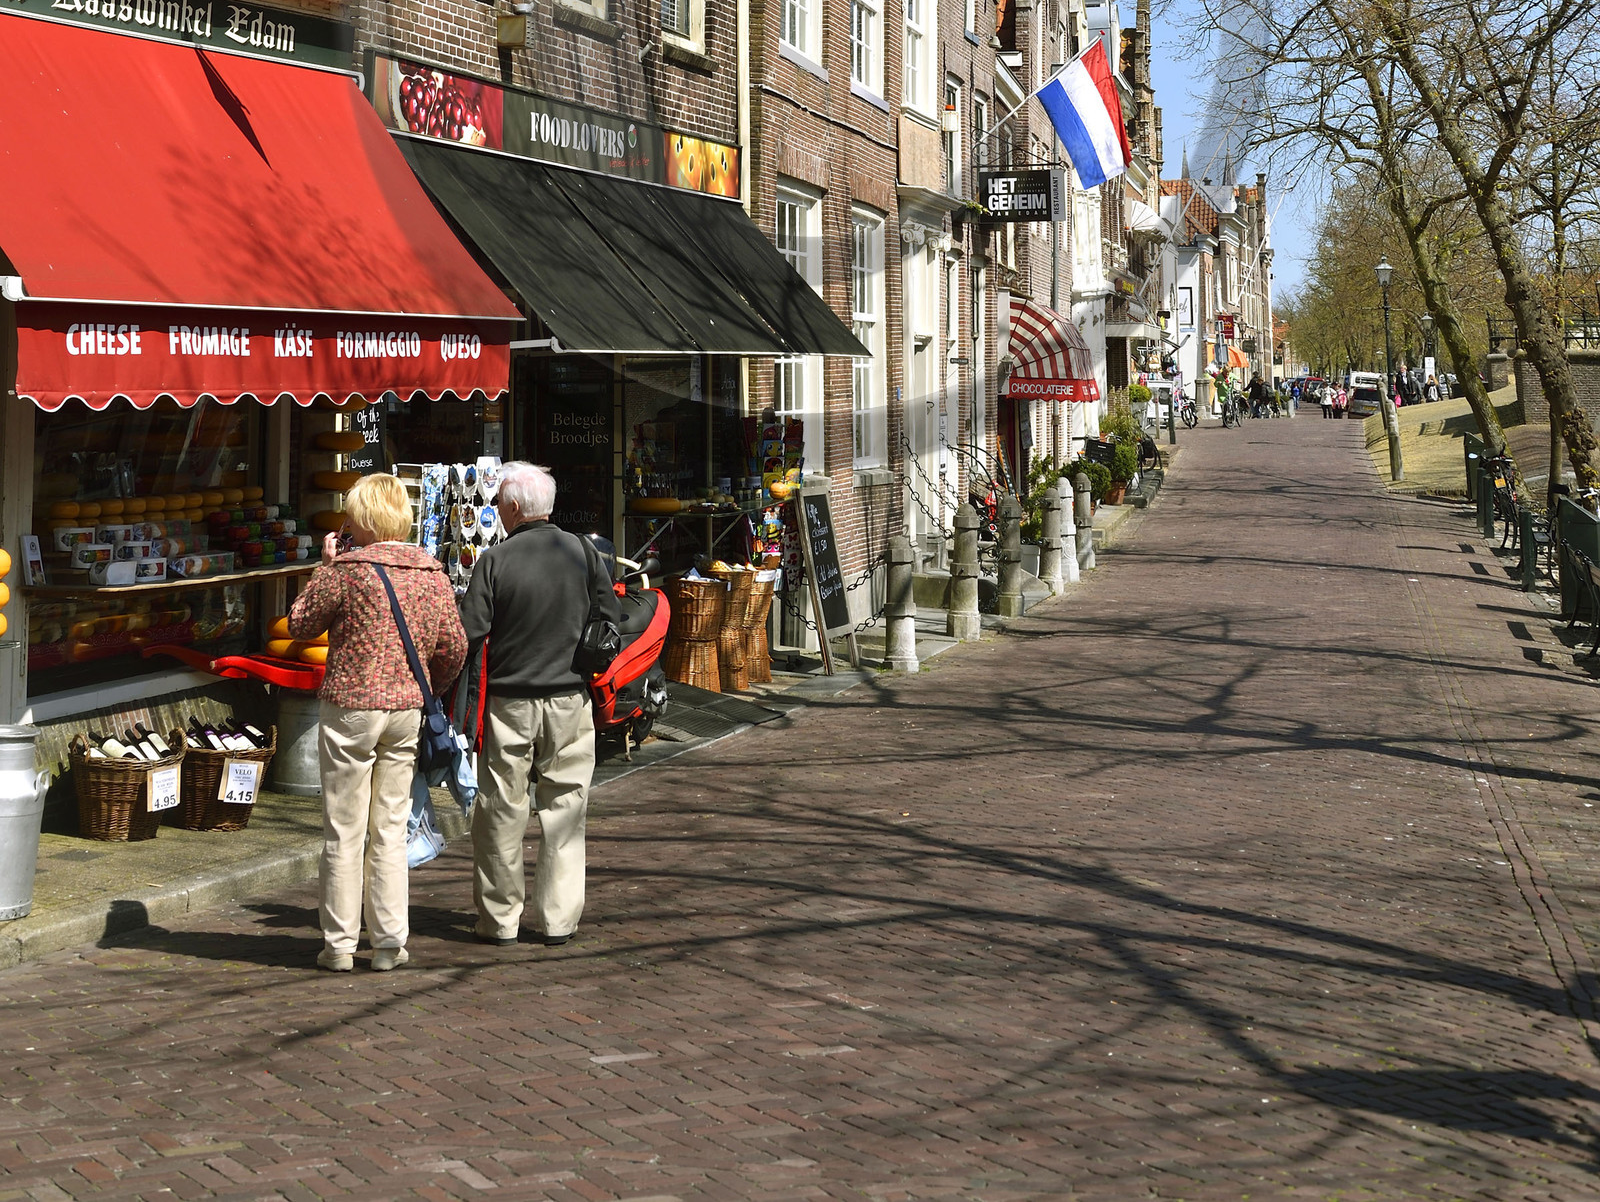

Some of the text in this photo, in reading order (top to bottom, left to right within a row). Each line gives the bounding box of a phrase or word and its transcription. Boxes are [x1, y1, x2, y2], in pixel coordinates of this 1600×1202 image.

[224, 4, 296, 53] Edam
[987, 178, 1017, 194] HET
[988, 194, 1047, 211] GEHEIM
[66, 322, 481, 362] CHEESE FROMAGE KÄSE FORMAGGIO QUESO
[1011, 383, 1074, 396] CHOCOLATERIE
[552, 412, 607, 429] Belegde
[359, 424, 380, 444] eek
[550, 431, 609, 447] Broodjes
[234, 768, 252, 776] VELO
[154, 794, 177, 809] 4.95
[226, 790, 253, 802] 4.15
